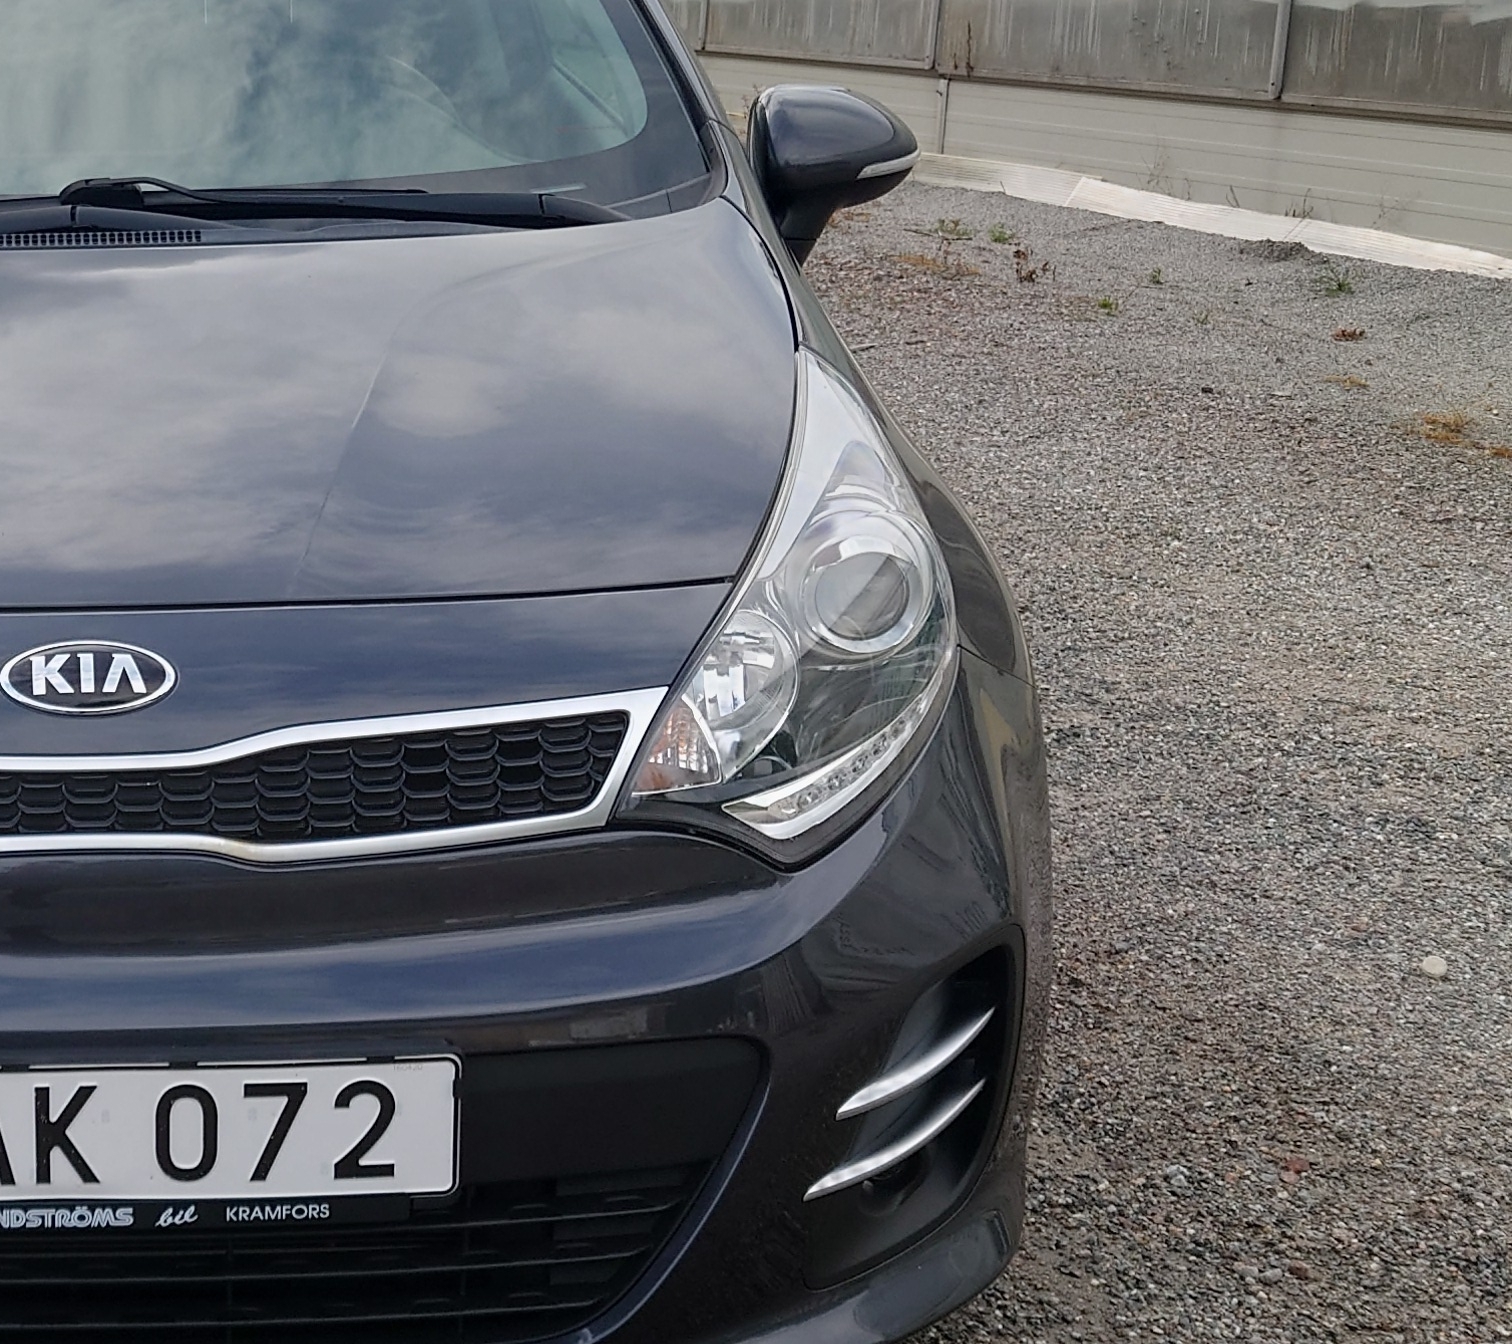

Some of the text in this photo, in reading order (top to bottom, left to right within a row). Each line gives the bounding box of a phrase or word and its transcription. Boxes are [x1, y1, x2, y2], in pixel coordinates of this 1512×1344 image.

[29, 652, 147, 696] KIA
[154, 1079, 396, 1182] 072
[154, 1204, 199, 1228] bil
[225, 1203, 331, 1222] KRAMFORS
